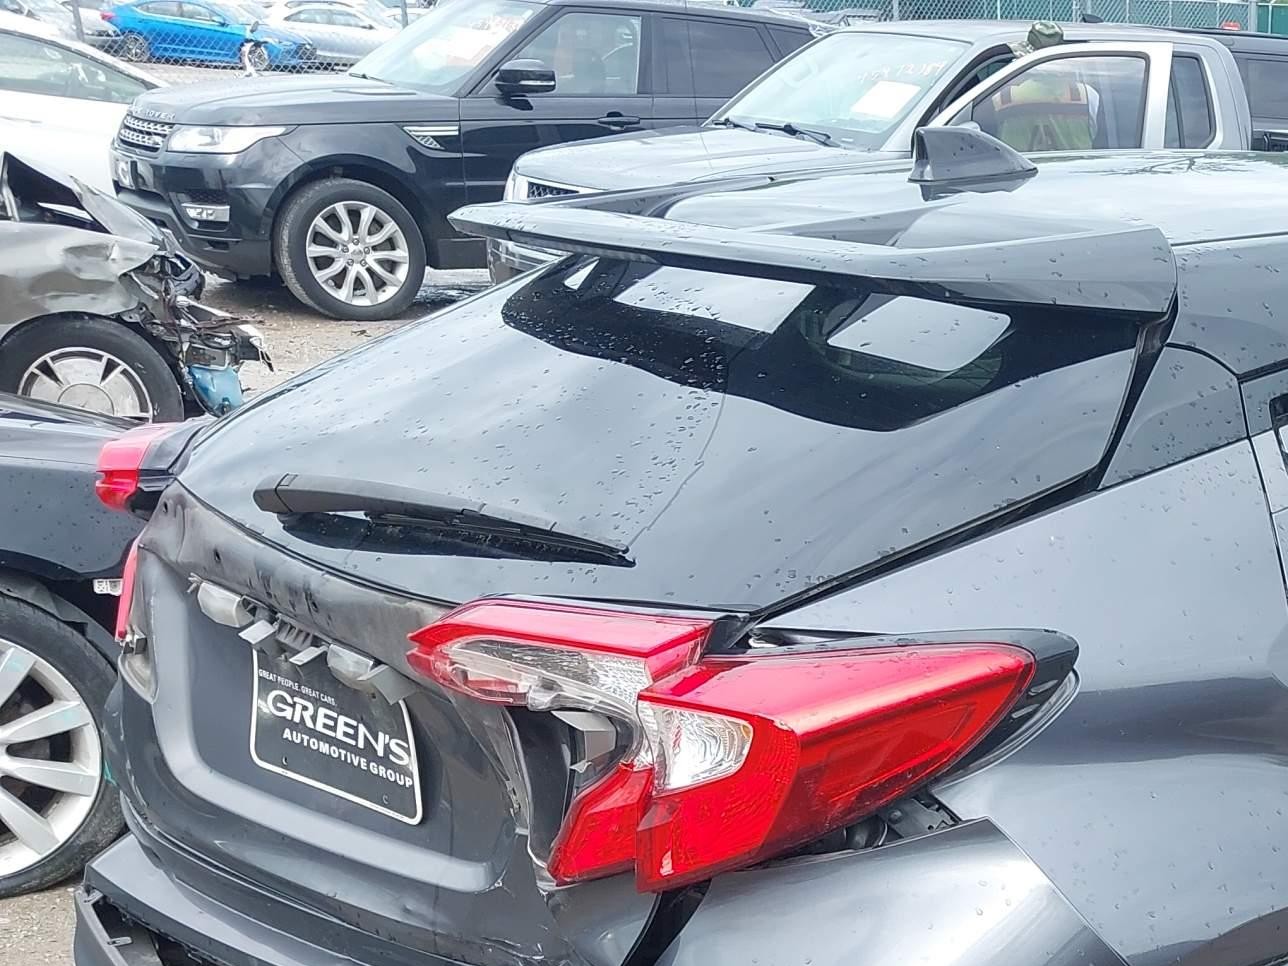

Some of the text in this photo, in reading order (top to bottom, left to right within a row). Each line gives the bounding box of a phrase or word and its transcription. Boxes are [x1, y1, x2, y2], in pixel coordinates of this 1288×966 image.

[258, 668, 277, 682] GREAT
[301, 685, 320, 699] GREAT
[266, 689, 410, 766] GREEN'S
[282, 727, 414, 788] AUTOMOTIVE GROUP
